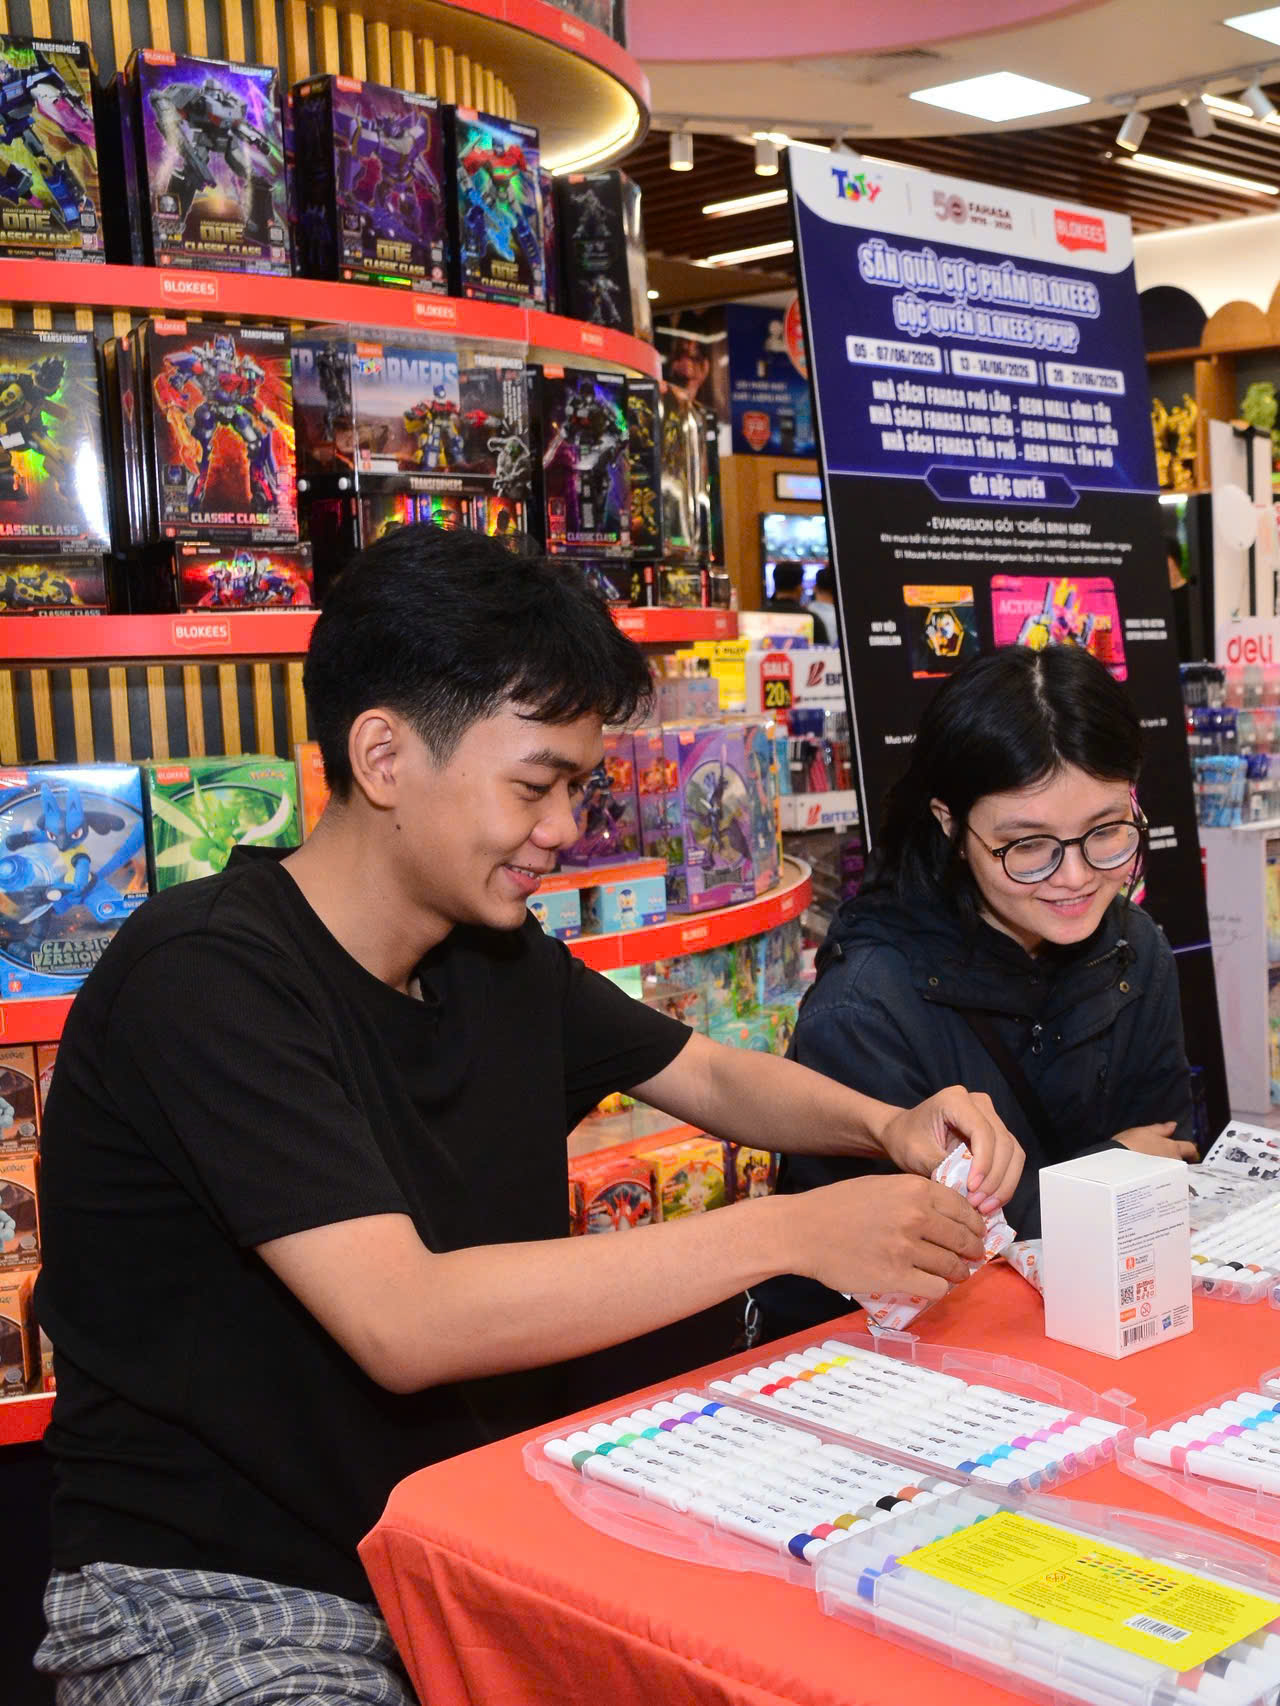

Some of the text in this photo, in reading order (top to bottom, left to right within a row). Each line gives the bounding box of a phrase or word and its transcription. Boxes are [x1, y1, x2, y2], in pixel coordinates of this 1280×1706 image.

[32, 42, 81, 55] TRANSFORMERS
[969, 202, 1011, 220] FAHASA
[2, 213, 51, 231] ONE
[0, 231, 34, 243] ASSIC
[200, 226, 245, 242] ONE
[1056, 219, 1105, 243] BLOKEES
[184, 241, 262, 257] CLASSIC CLASS
[163, 279, 215, 296] BLOKEES
[1031, 273, 1099, 314] BLOKEES
[415, 303, 455, 319] BLOKEES
[38, 333, 88, 345] TRANSFORMERS
[240, 329, 285, 341] TRANSFORMERS
[190, 511, 270, 525] CLASSIC CLASS
[931, 516, 994, 532] EVANGELION
[41, 525, 79, 537] CLASS
[175, 625, 228, 639] BLOKEES
[1226, 634, 1273, 664] deli
[762, 661, 790, 677] SALE
[41, 937, 112, 954] CLASSIC
[33, 950, 103, 966] VERSION
